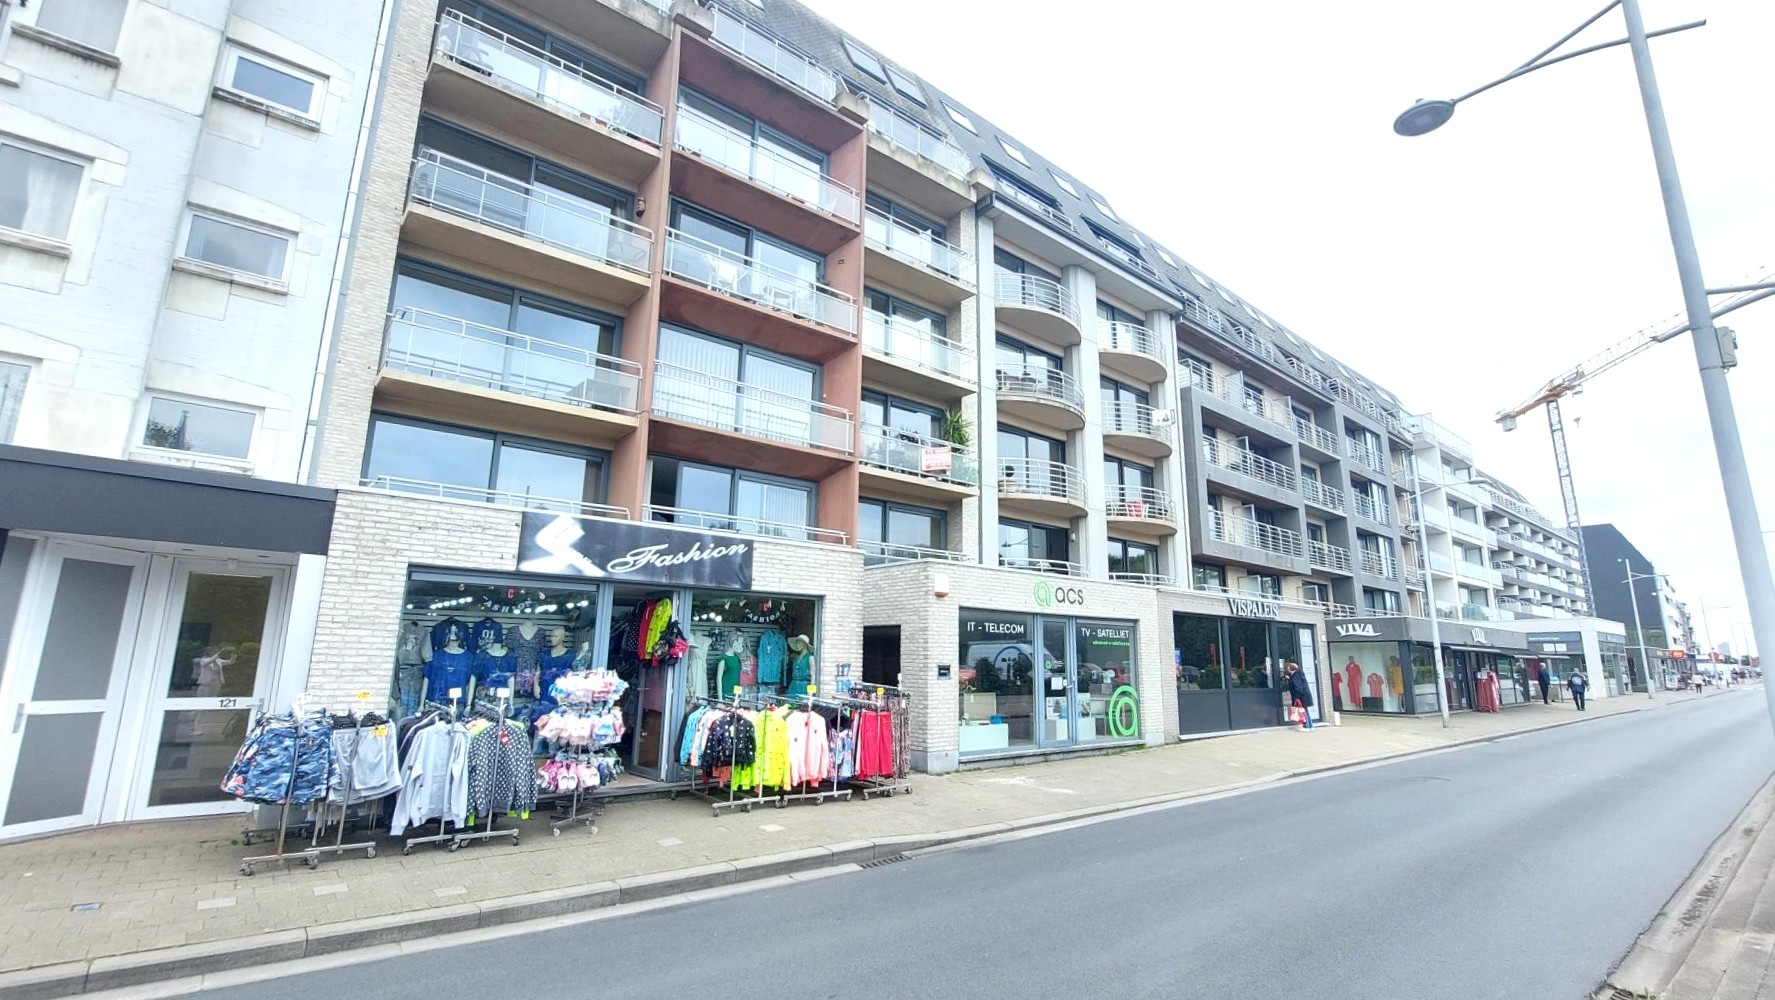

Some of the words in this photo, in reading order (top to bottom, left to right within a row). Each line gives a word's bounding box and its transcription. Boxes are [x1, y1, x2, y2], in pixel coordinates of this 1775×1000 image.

[606, 541, 749, 574] Fashion
[1054, 586, 1084, 605] acs
[1226, 598, 1279, 619] VISPALEIS
[967, 622, 976, 632] IT
[984, 622, 1025, 635] TELECOM
[1081, 627, 1091, 637] TV
[1097, 628, 1130, 639] SATELLIET
[1335, 622, 1376, 636] VIVA
[218, 698, 237, 708] 121
